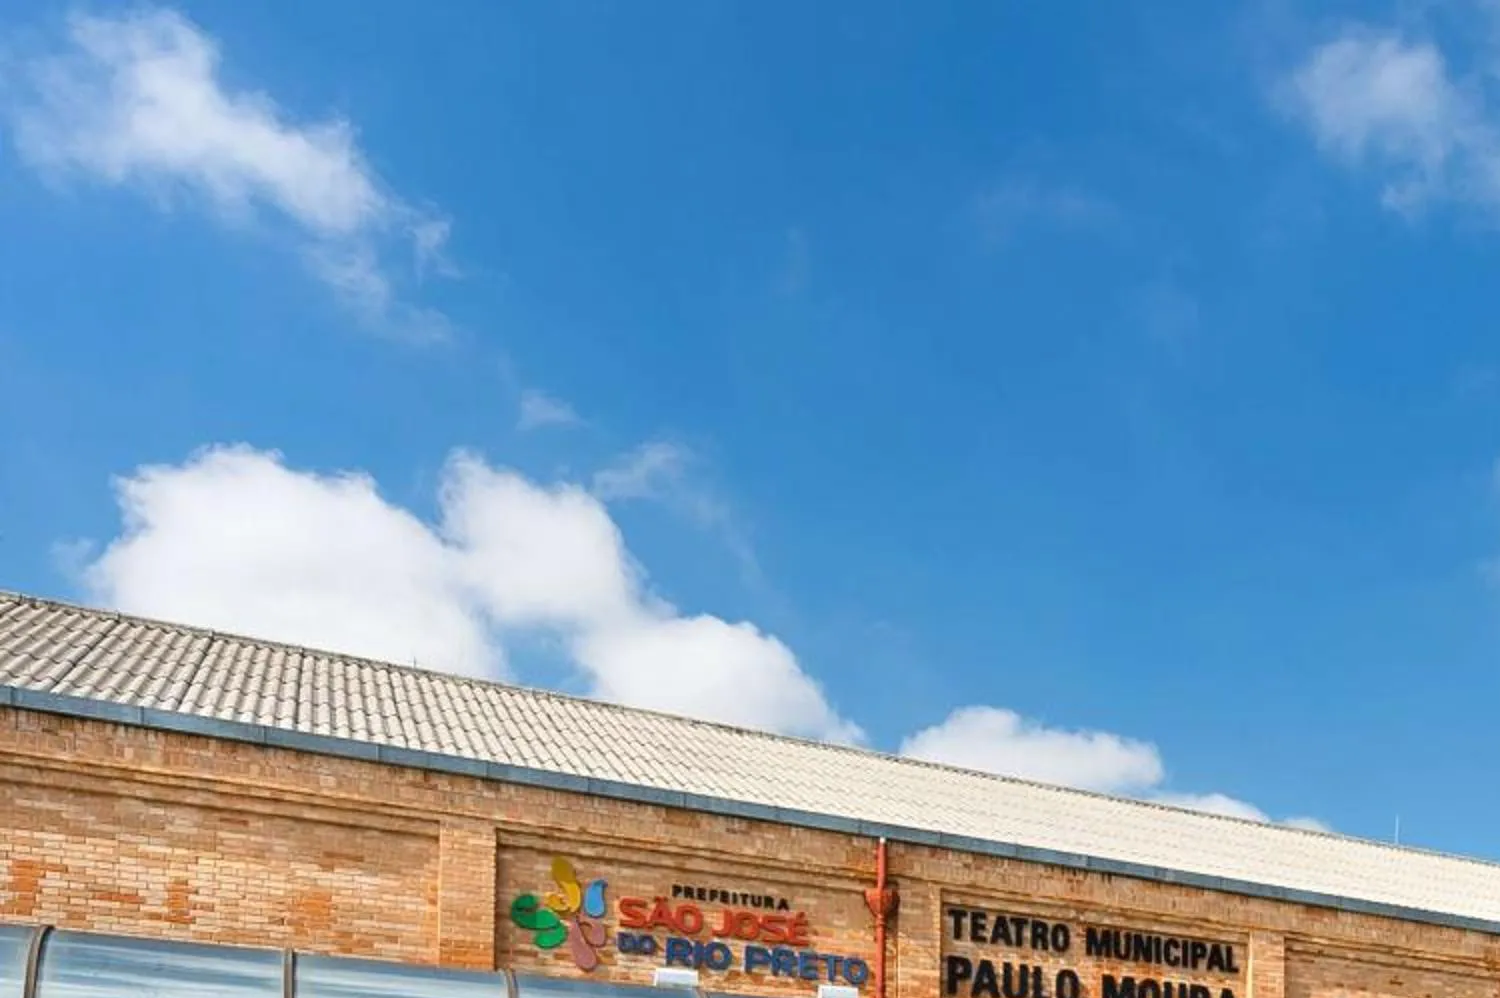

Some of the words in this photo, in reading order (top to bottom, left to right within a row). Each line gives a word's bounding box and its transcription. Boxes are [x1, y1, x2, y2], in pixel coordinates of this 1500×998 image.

[619, 896, 704, 936] SÃO
[711, 909, 810, 947] JOSÉ
[671, 884, 790, 912] PREFEITURA
[616, 931, 657, 955] DO
[665, 936, 733, 971] RIO
[744, 945, 870, 985] PRETO
[947, 909, 1071, 953] TEATRO
[1085, 926, 1240, 974] MUNICIPAL
